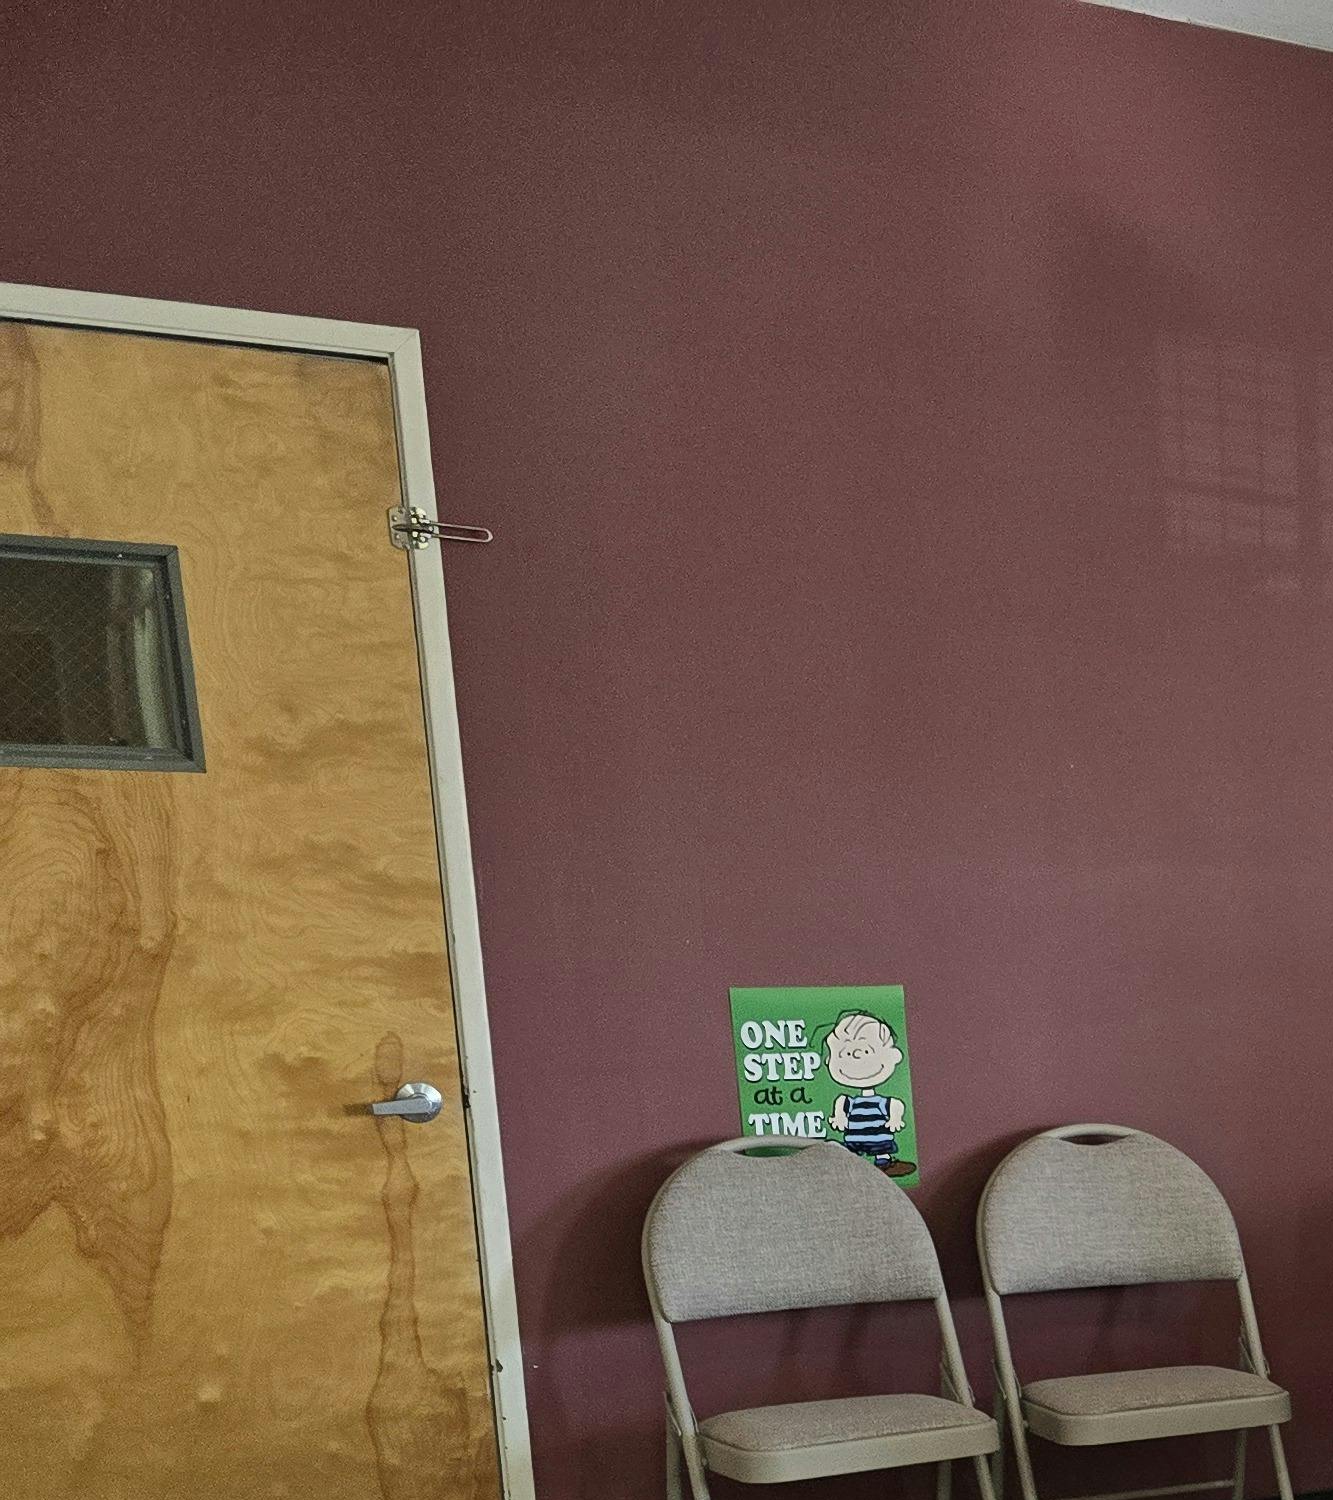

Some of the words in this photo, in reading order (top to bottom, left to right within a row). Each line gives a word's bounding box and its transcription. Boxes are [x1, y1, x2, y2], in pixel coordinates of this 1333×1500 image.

[740, 1020, 808, 1049] ONE
[743, 1052, 821, 1082] STEP
[754, 1086, 783, 1105] at
[790, 1086, 813, 1104] a
[748, 1111, 828, 1139] TIME
